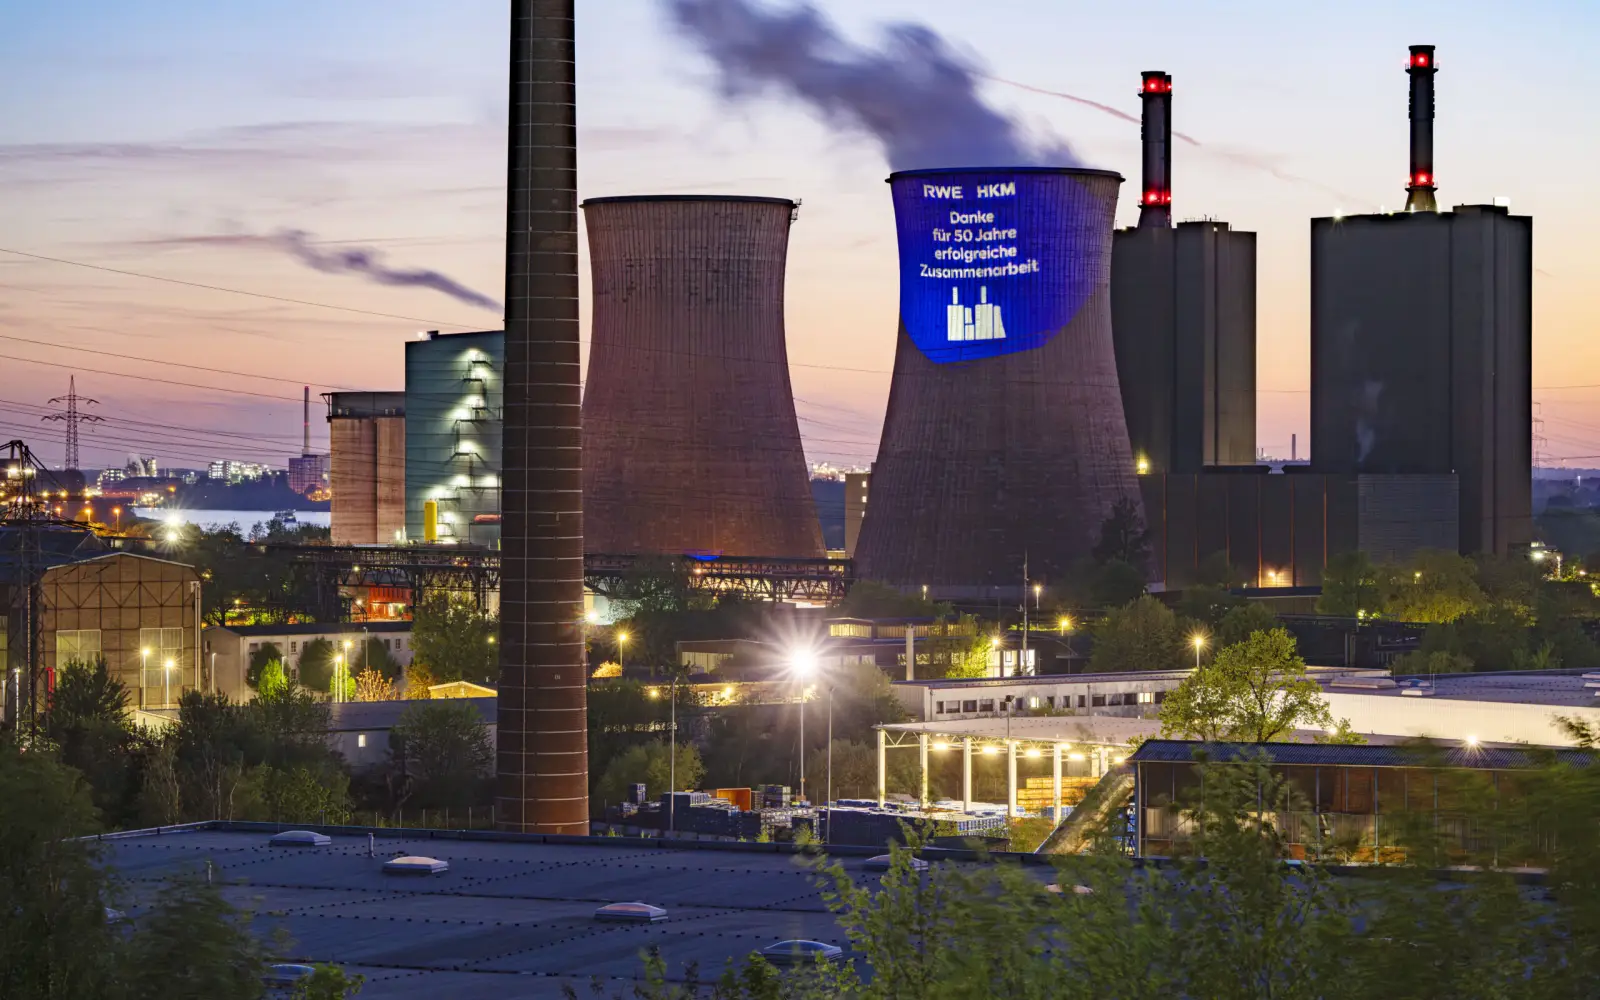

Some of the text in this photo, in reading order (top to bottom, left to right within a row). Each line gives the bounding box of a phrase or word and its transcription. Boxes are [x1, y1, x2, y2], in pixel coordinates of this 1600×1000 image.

[923, 182, 1016, 199] RWE HKM
[950, 210, 995, 224] Danke
[932, 227, 1017, 242] für 50 Jahre
[935, 244, 1018, 263] erfolgreiche
[920, 259, 1040, 278] Zusammenarbeit
